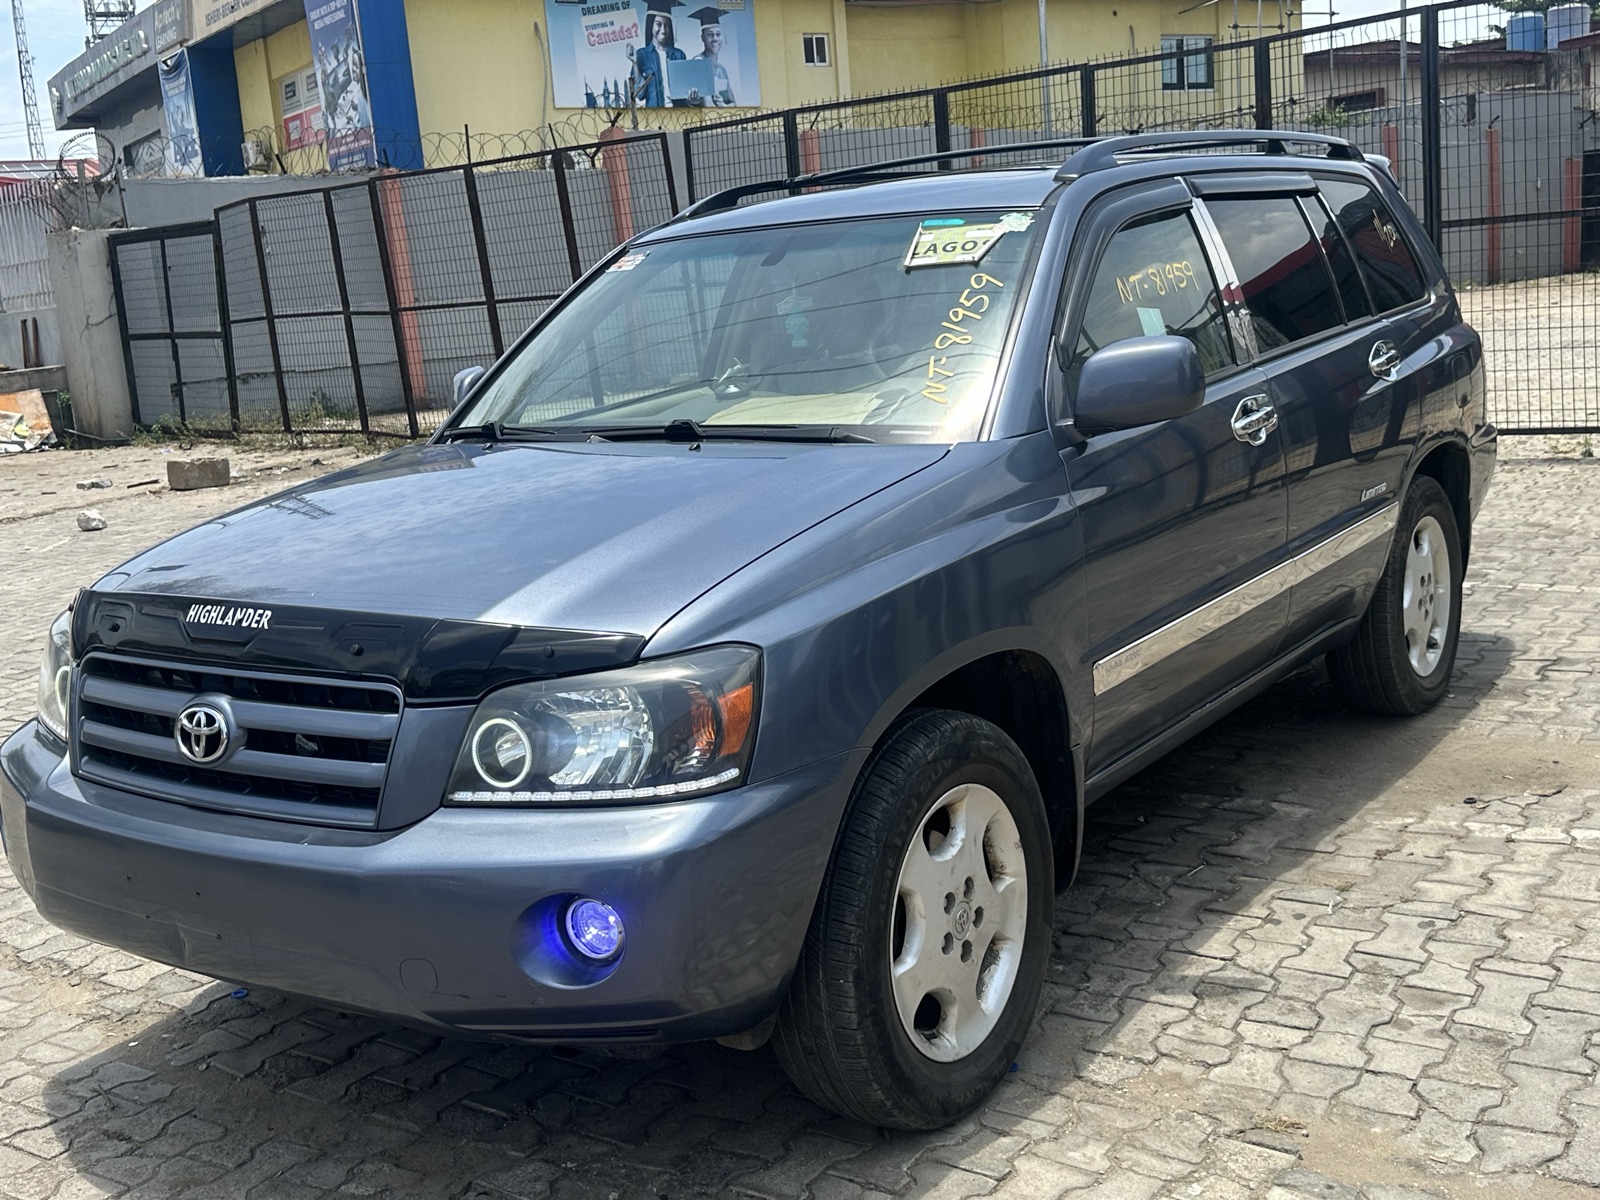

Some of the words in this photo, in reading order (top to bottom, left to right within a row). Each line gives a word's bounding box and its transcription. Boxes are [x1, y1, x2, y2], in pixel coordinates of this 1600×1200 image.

[581, 4, 620, 16] DREAMING
[621, 1, 631, 10] OF
[156, 26, 177, 50] LEARNING
[585, 21, 609, 32] STUDYING
[586, 22, 639, 47] Canada?
[186, 604, 272, 629] HIGHLANDER
